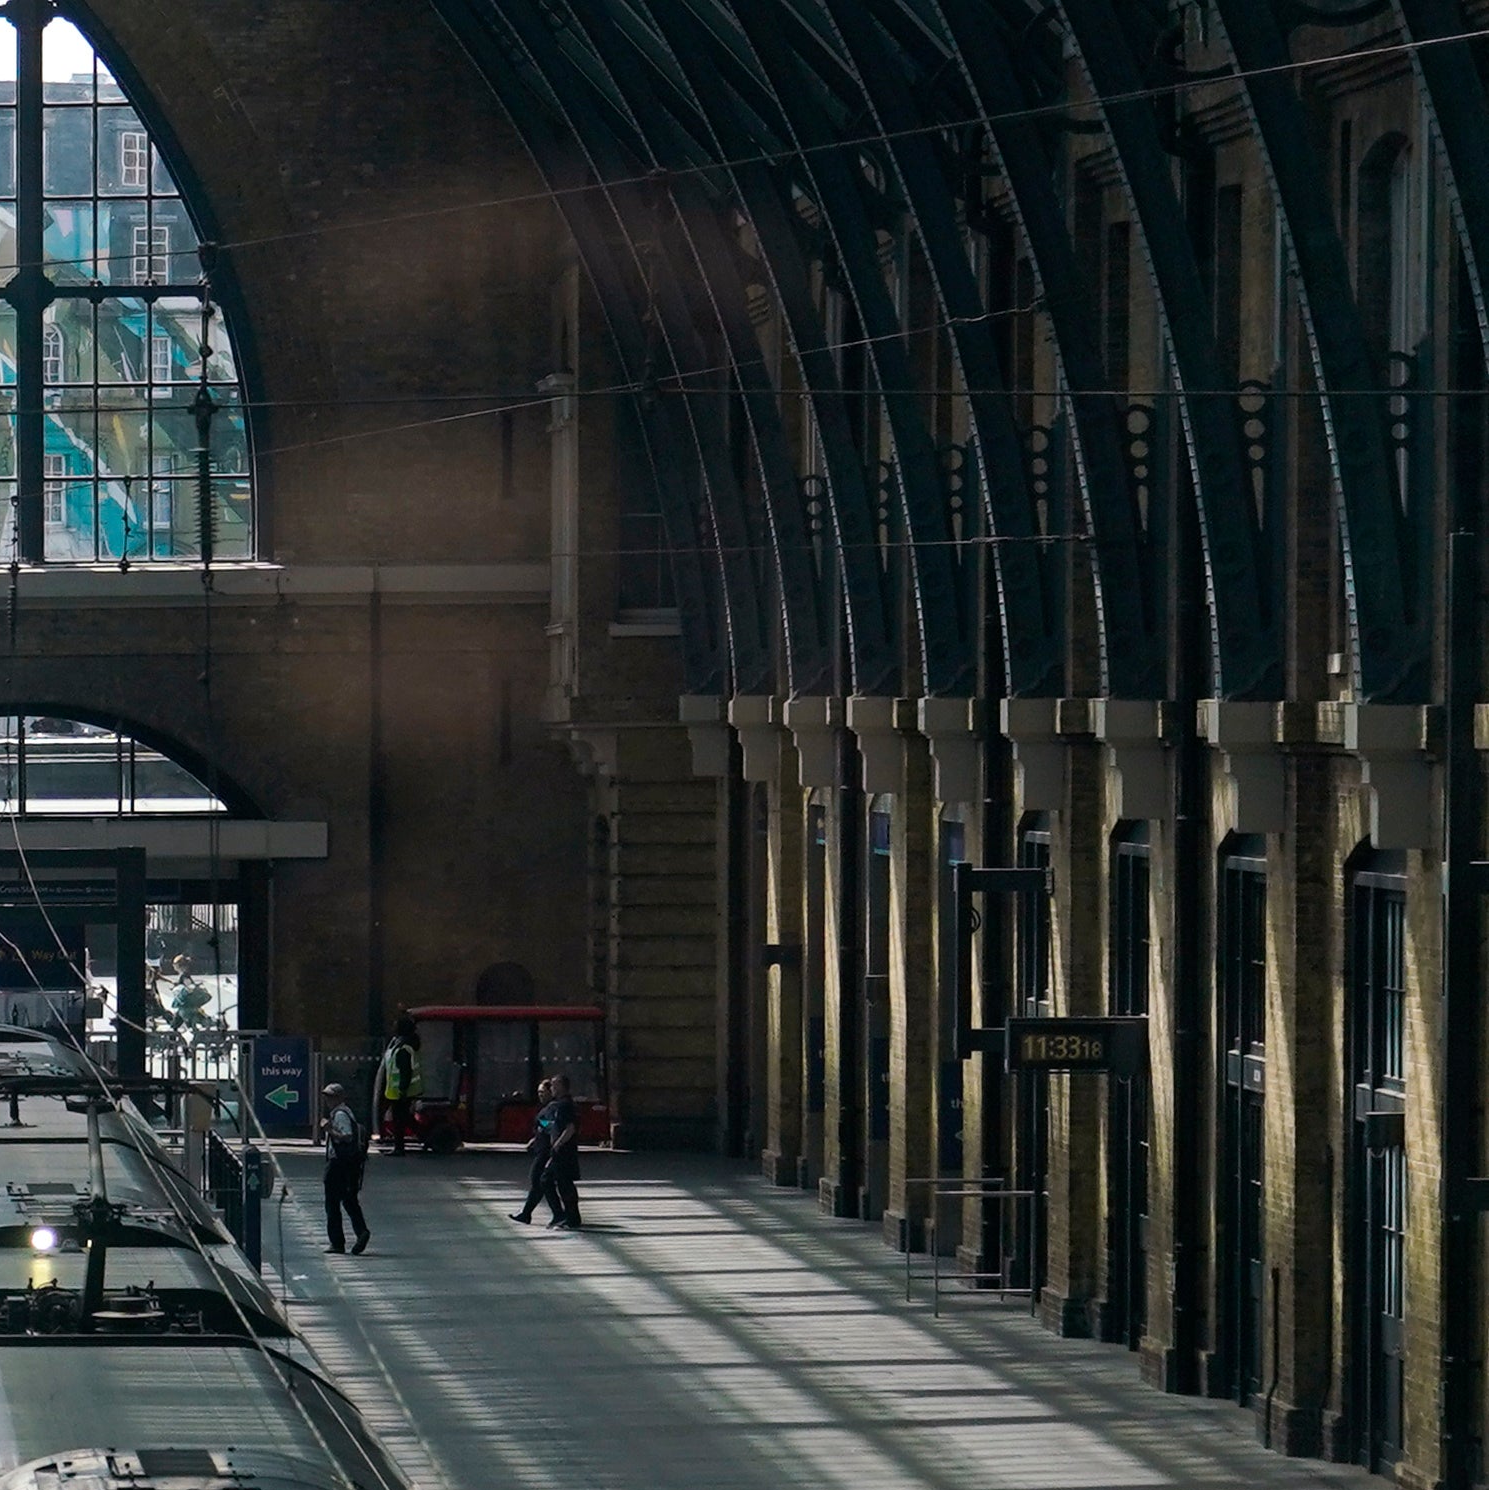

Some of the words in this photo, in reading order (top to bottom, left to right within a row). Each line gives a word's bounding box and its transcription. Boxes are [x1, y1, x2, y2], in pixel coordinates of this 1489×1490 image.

[271, 1053, 292, 1064] Exit
[261, 1066, 281, 1077] this
[282, 1067, 303, 1078] way
